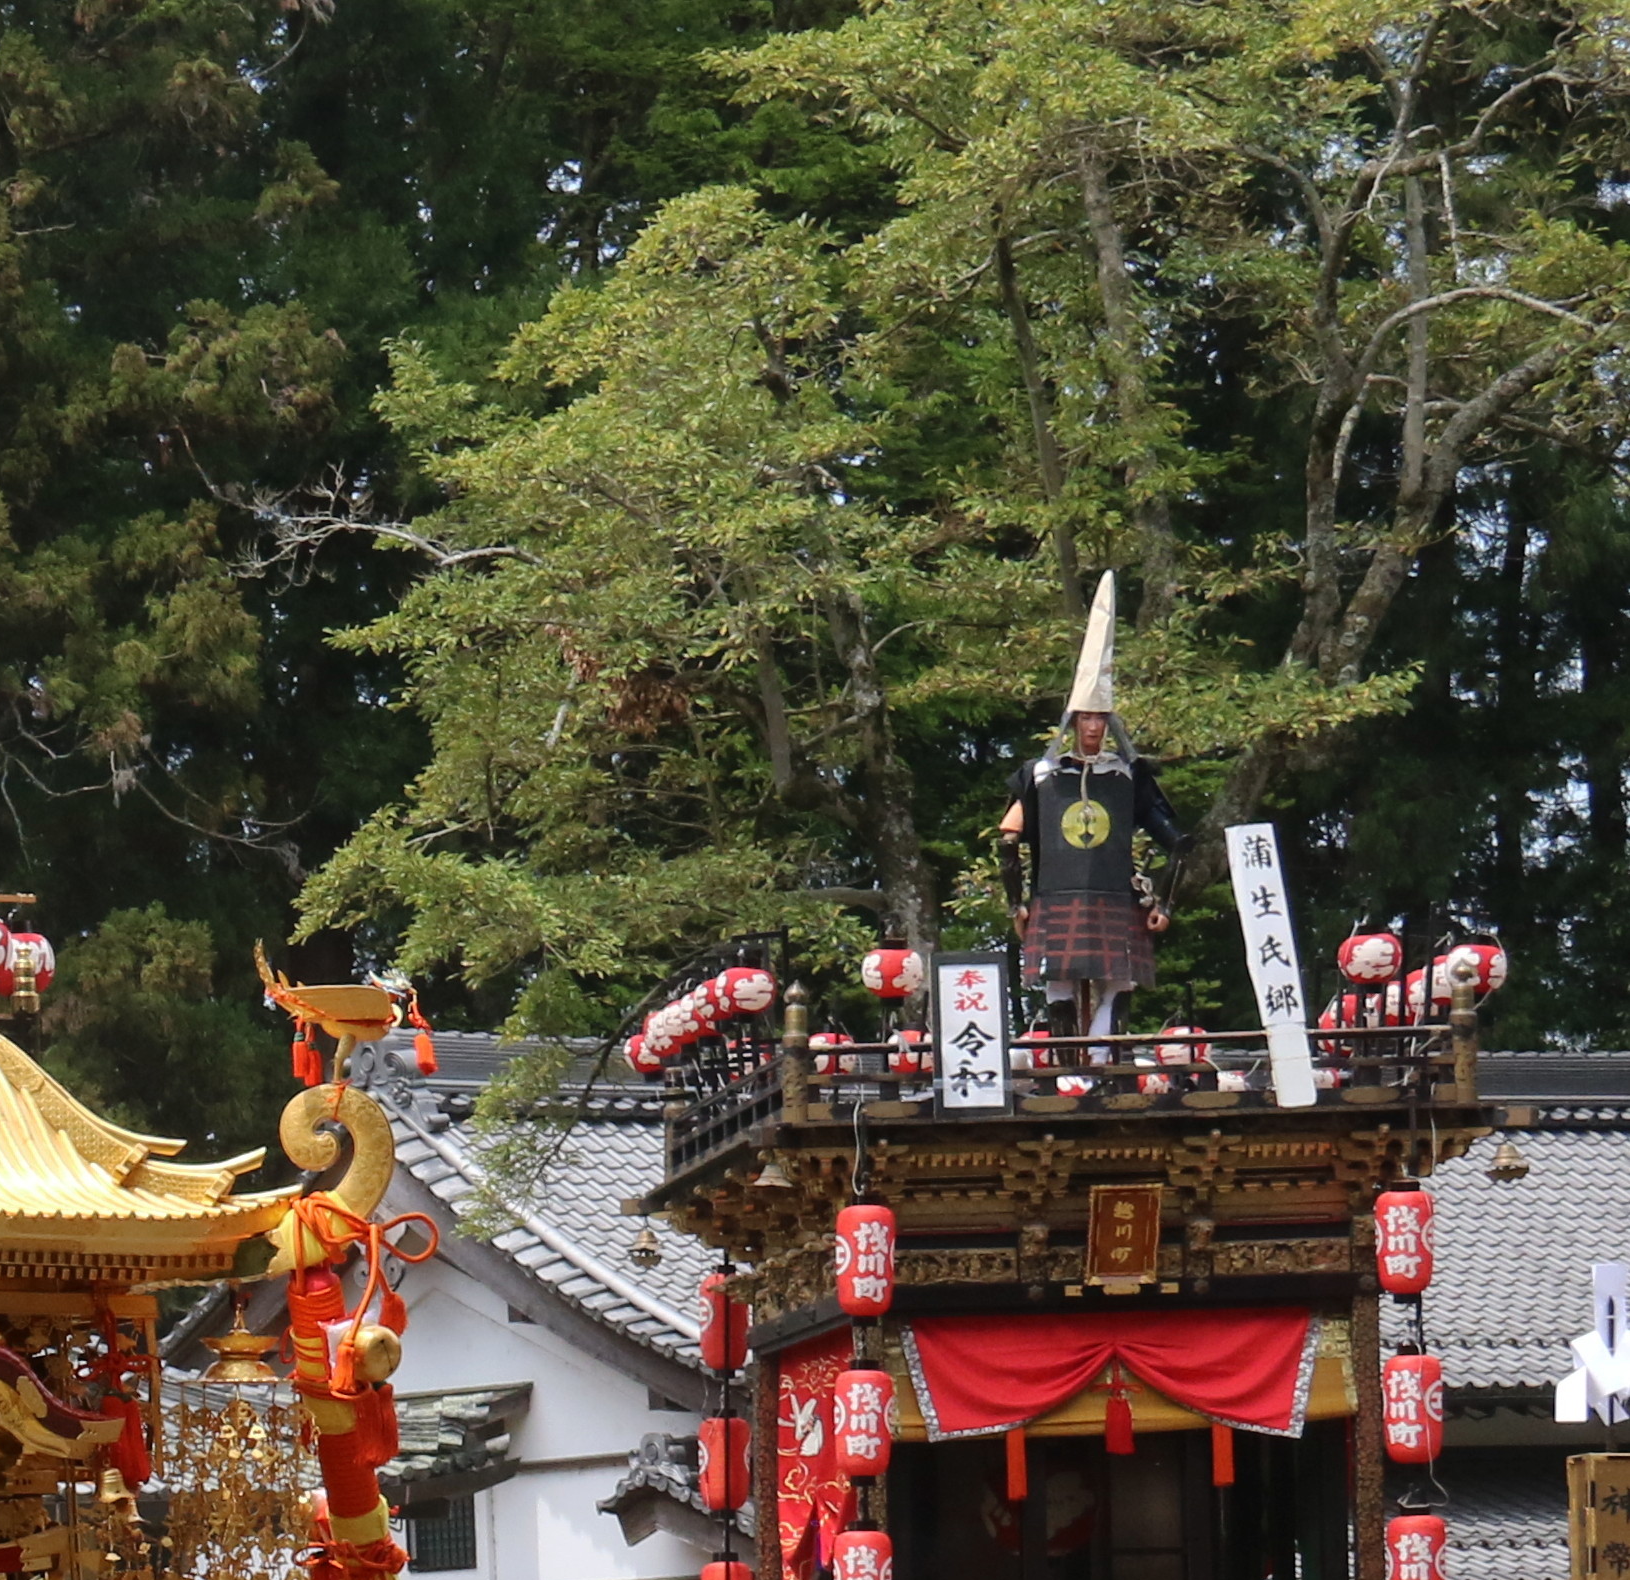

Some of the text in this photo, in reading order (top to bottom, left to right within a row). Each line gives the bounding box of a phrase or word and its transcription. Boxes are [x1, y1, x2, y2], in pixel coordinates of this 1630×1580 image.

[1242, 835, 1300, 1018] 蒲生氏郷
[948, 969, 998, 1098] 奉祝 令和
